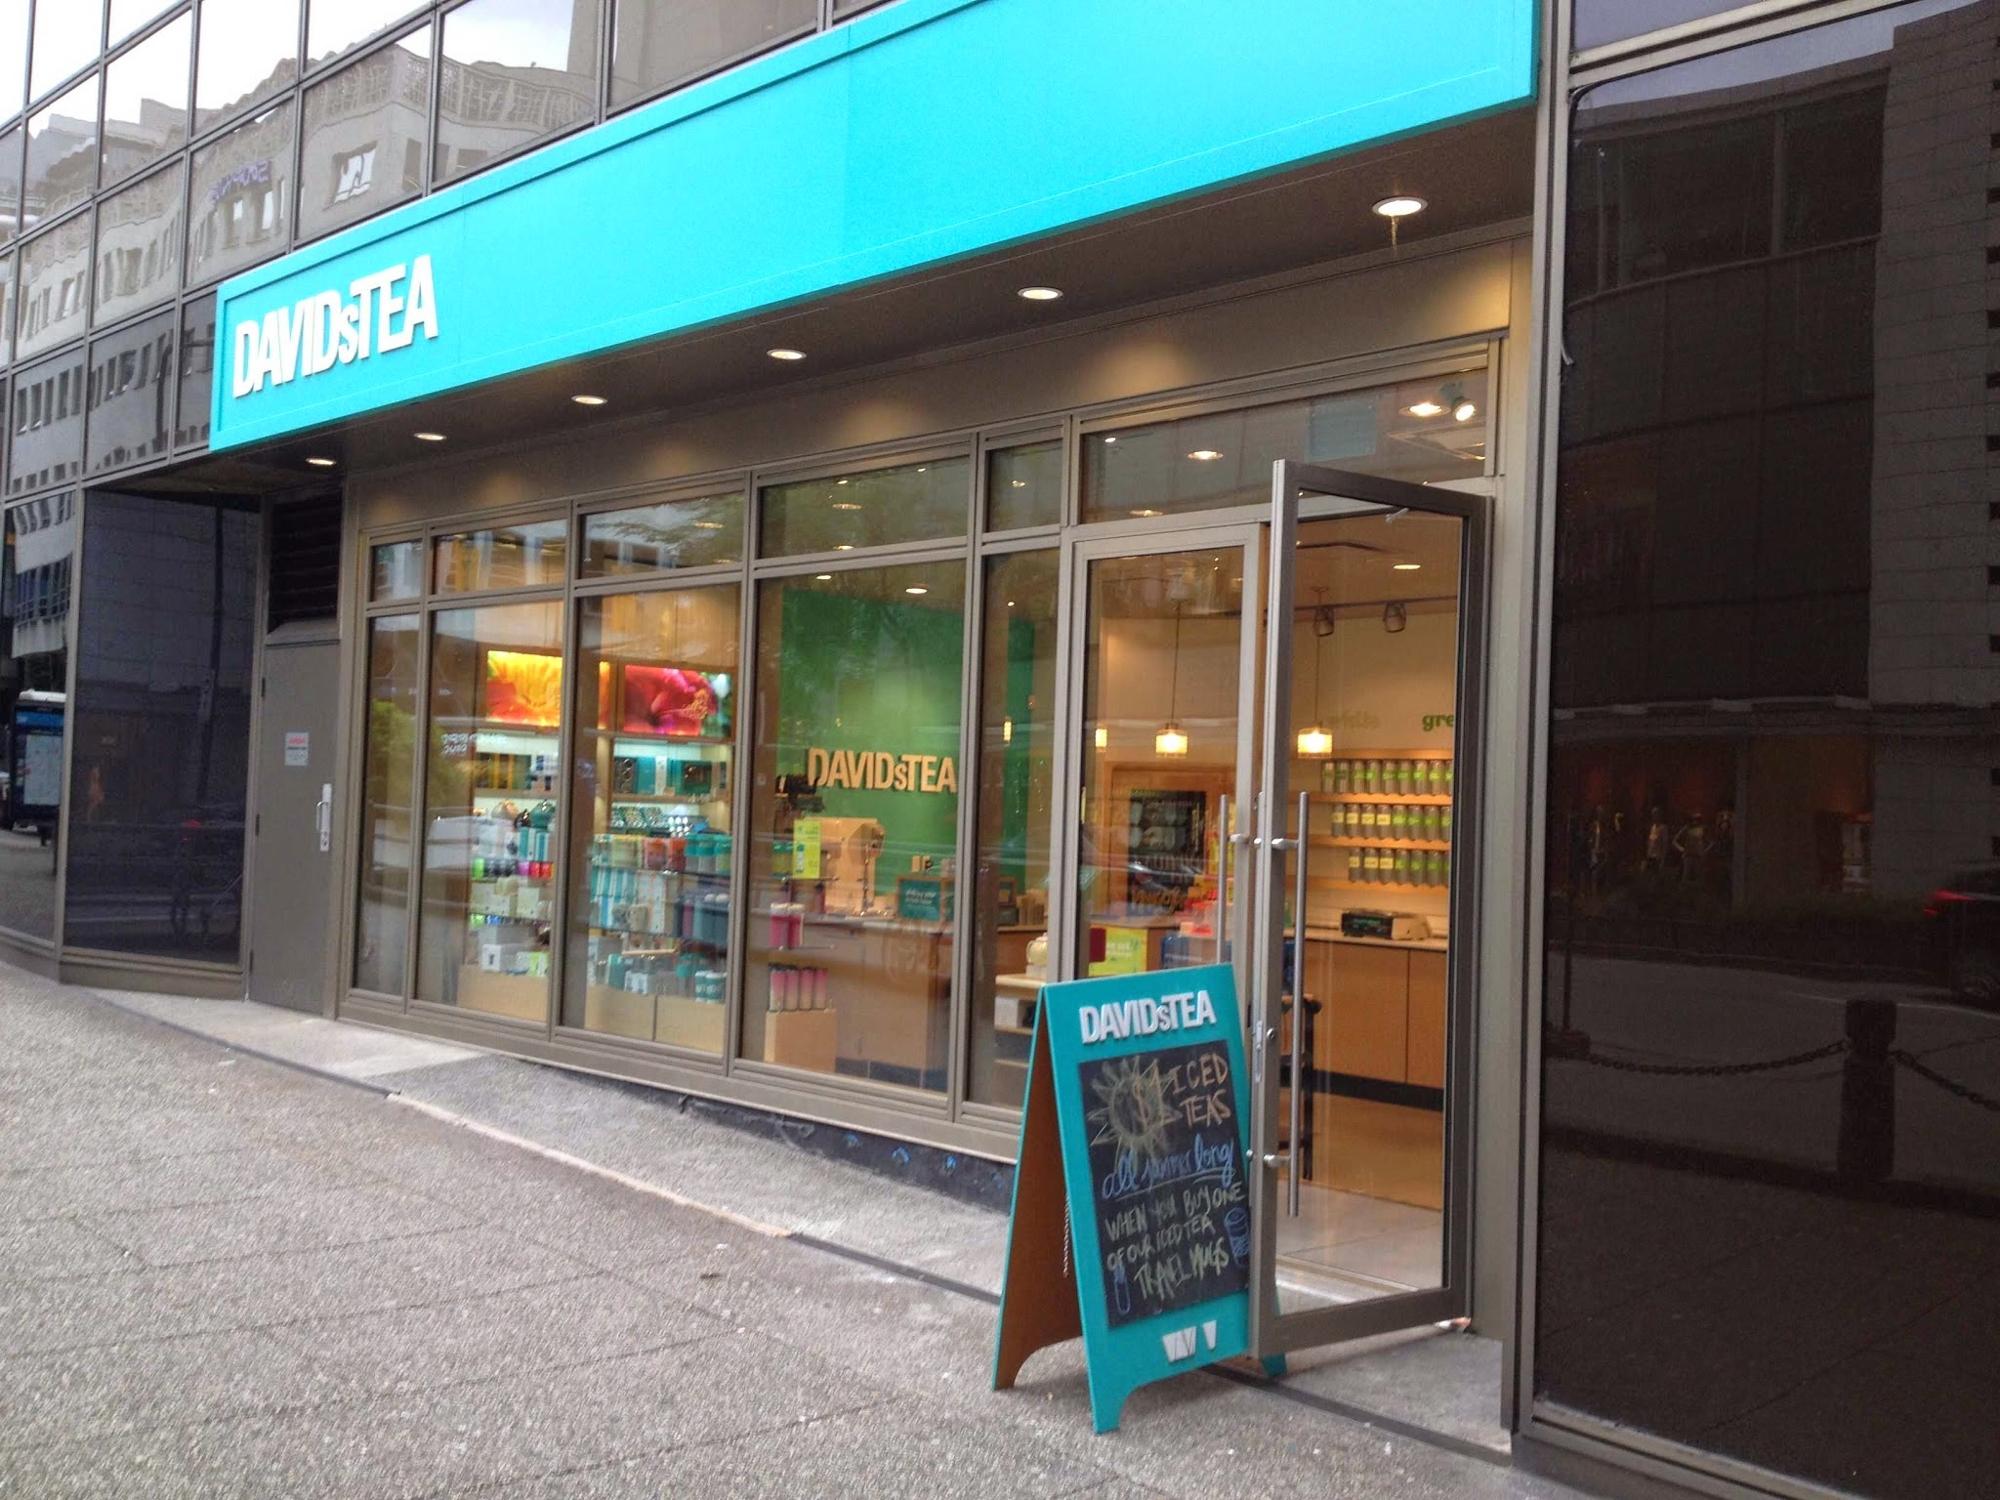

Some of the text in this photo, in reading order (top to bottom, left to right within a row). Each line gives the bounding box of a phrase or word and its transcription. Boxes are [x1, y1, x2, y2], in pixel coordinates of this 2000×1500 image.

[232, 253, 439, 399] DAVIDsTEA
[807, 747, 958, 793] DAVIDsTEA
[1079, 989, 1217, 1045] DAVIDsTEA
[1172, 1052, 1228, 1095] ICED
[1180, 1089, 1232, 1128] TEAS
[1194, 1133, 1235, 1188] long
[1104, 1203, 1148, 1241] WHEN
[1183, 1184, 1212, 1217] BUY
[1212, 1181, 1246, 1208] ONE
[1107, 1247, 1125, 1271] OF
[1183, 1213, 1216, 1241] TEA
[1189, 1236, 1230, 1280] MUGS
